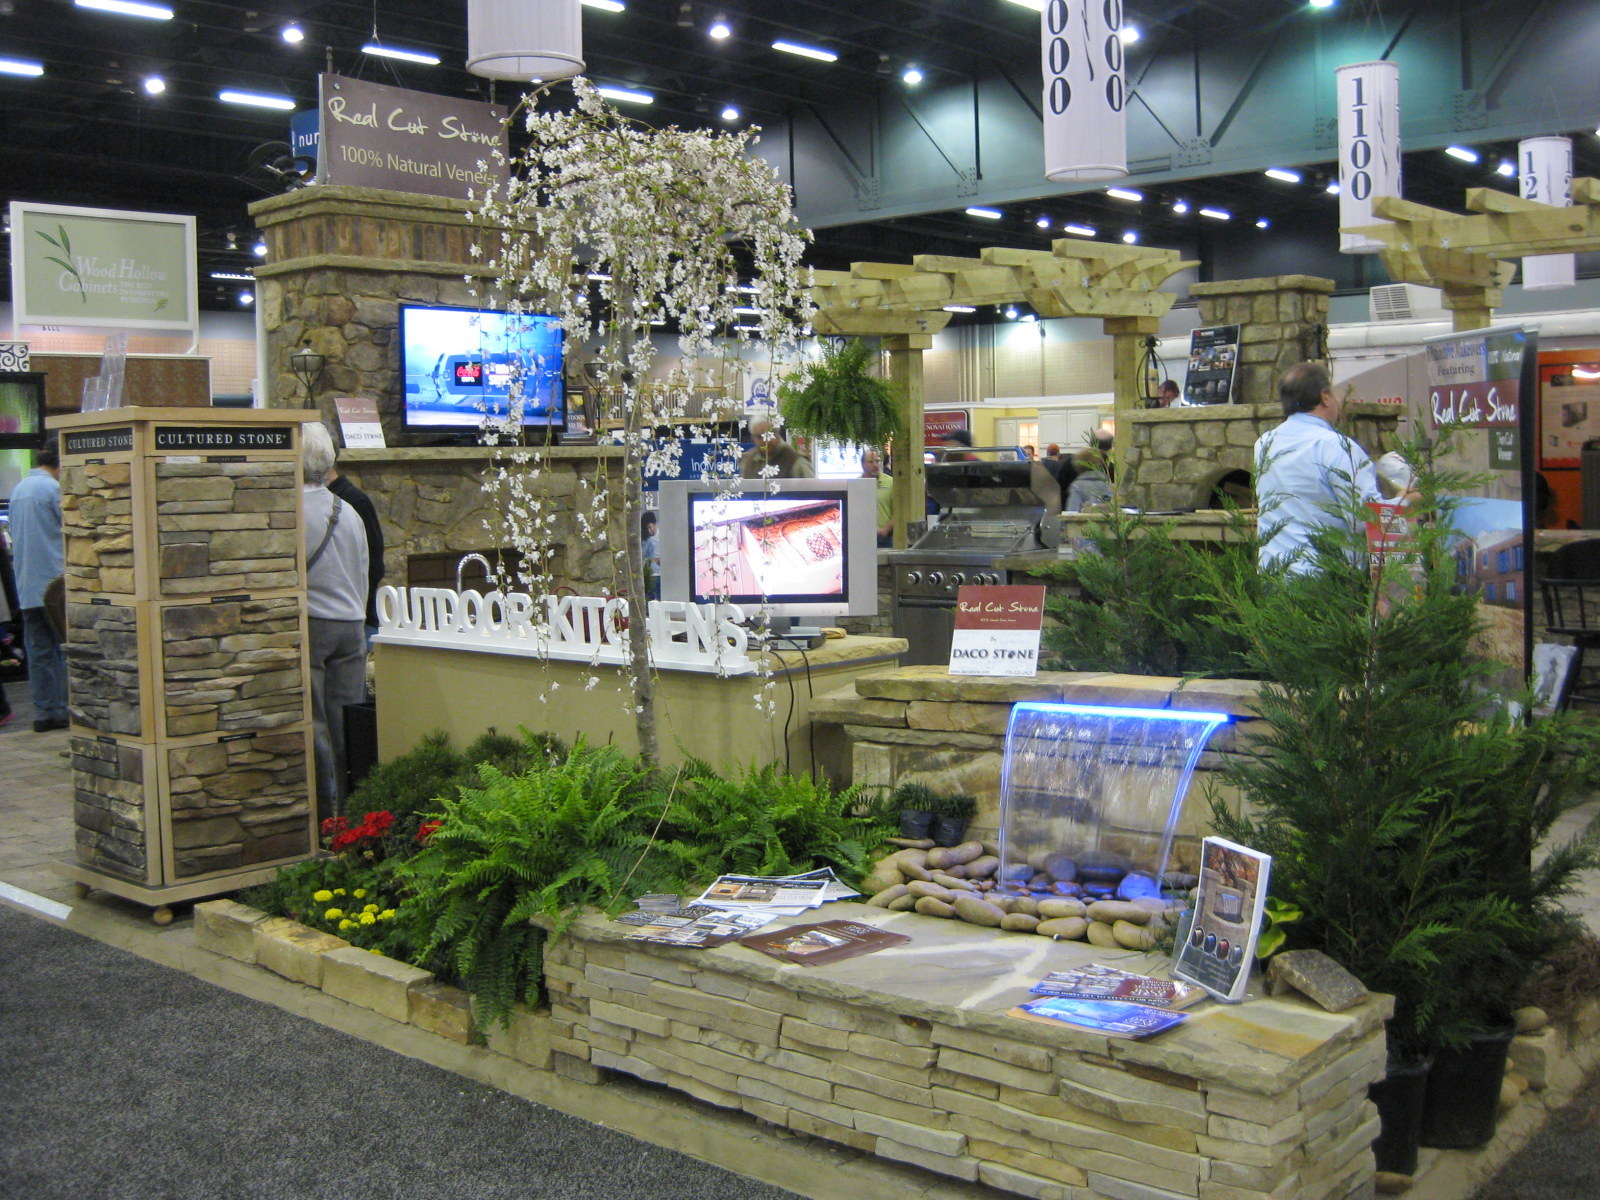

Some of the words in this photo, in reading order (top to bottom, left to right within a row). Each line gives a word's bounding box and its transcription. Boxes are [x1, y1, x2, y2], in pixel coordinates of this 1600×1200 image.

[328, 96, 378, 128] Real
[387, 108, 428, 135] Cut
[438, 116, 503, 147] Stone
[1350, 77, 1372, 201] 1100
[340, 145, 383, 168] 100%
[387, 153, 442, 178] Natural
[77, 256, 117, 278] Wood
[117, 258, 168, 281] Hollow
[68, 438, 105, 450] CULTURED
[108, 434, 133, 447] STONE
[158, 433, 233, 444] CULTURED
[376, 585, 536, 640] OUTDOOR
[960, 601, 981, 612] Real
[985, 601, 1004, 613] Cut
[1008, 601, 1039, 612] Stone
[953, 648, 989, 659] DACO
